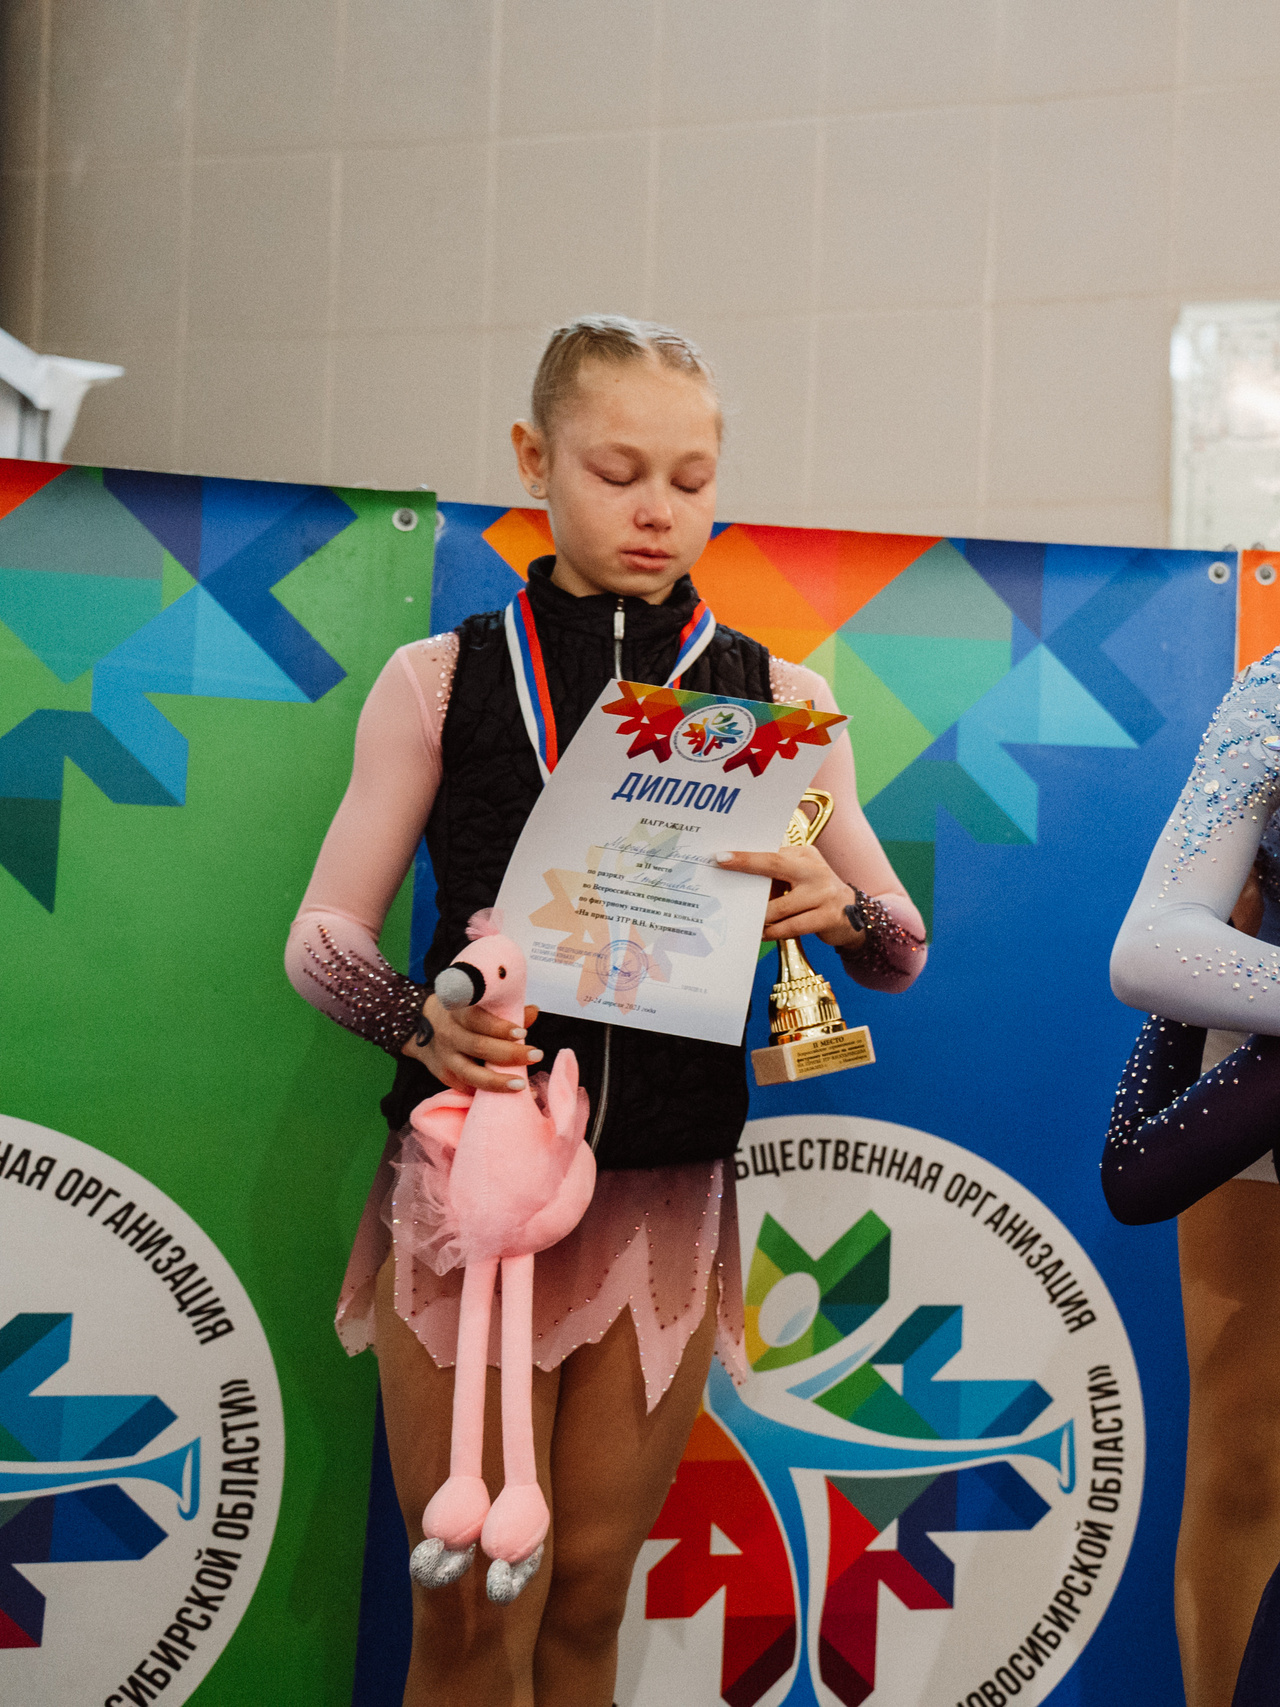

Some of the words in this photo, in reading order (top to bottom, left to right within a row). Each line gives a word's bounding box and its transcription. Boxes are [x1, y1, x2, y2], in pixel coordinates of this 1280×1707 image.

[611, 772, 741, 814] ДИПЛОМ
[640, 817, 701, 833] НАГРАЖДАЕТ
[597, 869, 625, 881] разряду
[652, 865, 673, 873] место
[592, 883, 645, 899] Всероссийских
[646, 893, 700, 909] соревнованиях
[588, 896, 628, 911] фигурному
[630, 905, 662, 916] катанию
[673, 913, 703, 924] коньках
[590, 911, 614, 922] призы
[602, 999, 625, 1009] апреля
[820, 1036, 844, 1047] МЕСТО
[54, 1168, 235, 1345] ОРГАНИЗАЦИЯ
[944, 1173, 1096, 1334] ОРГАНИЗАЦИЯ
[957, 1522, 1116, 1707] ОВОСИБИРСКОЙ
